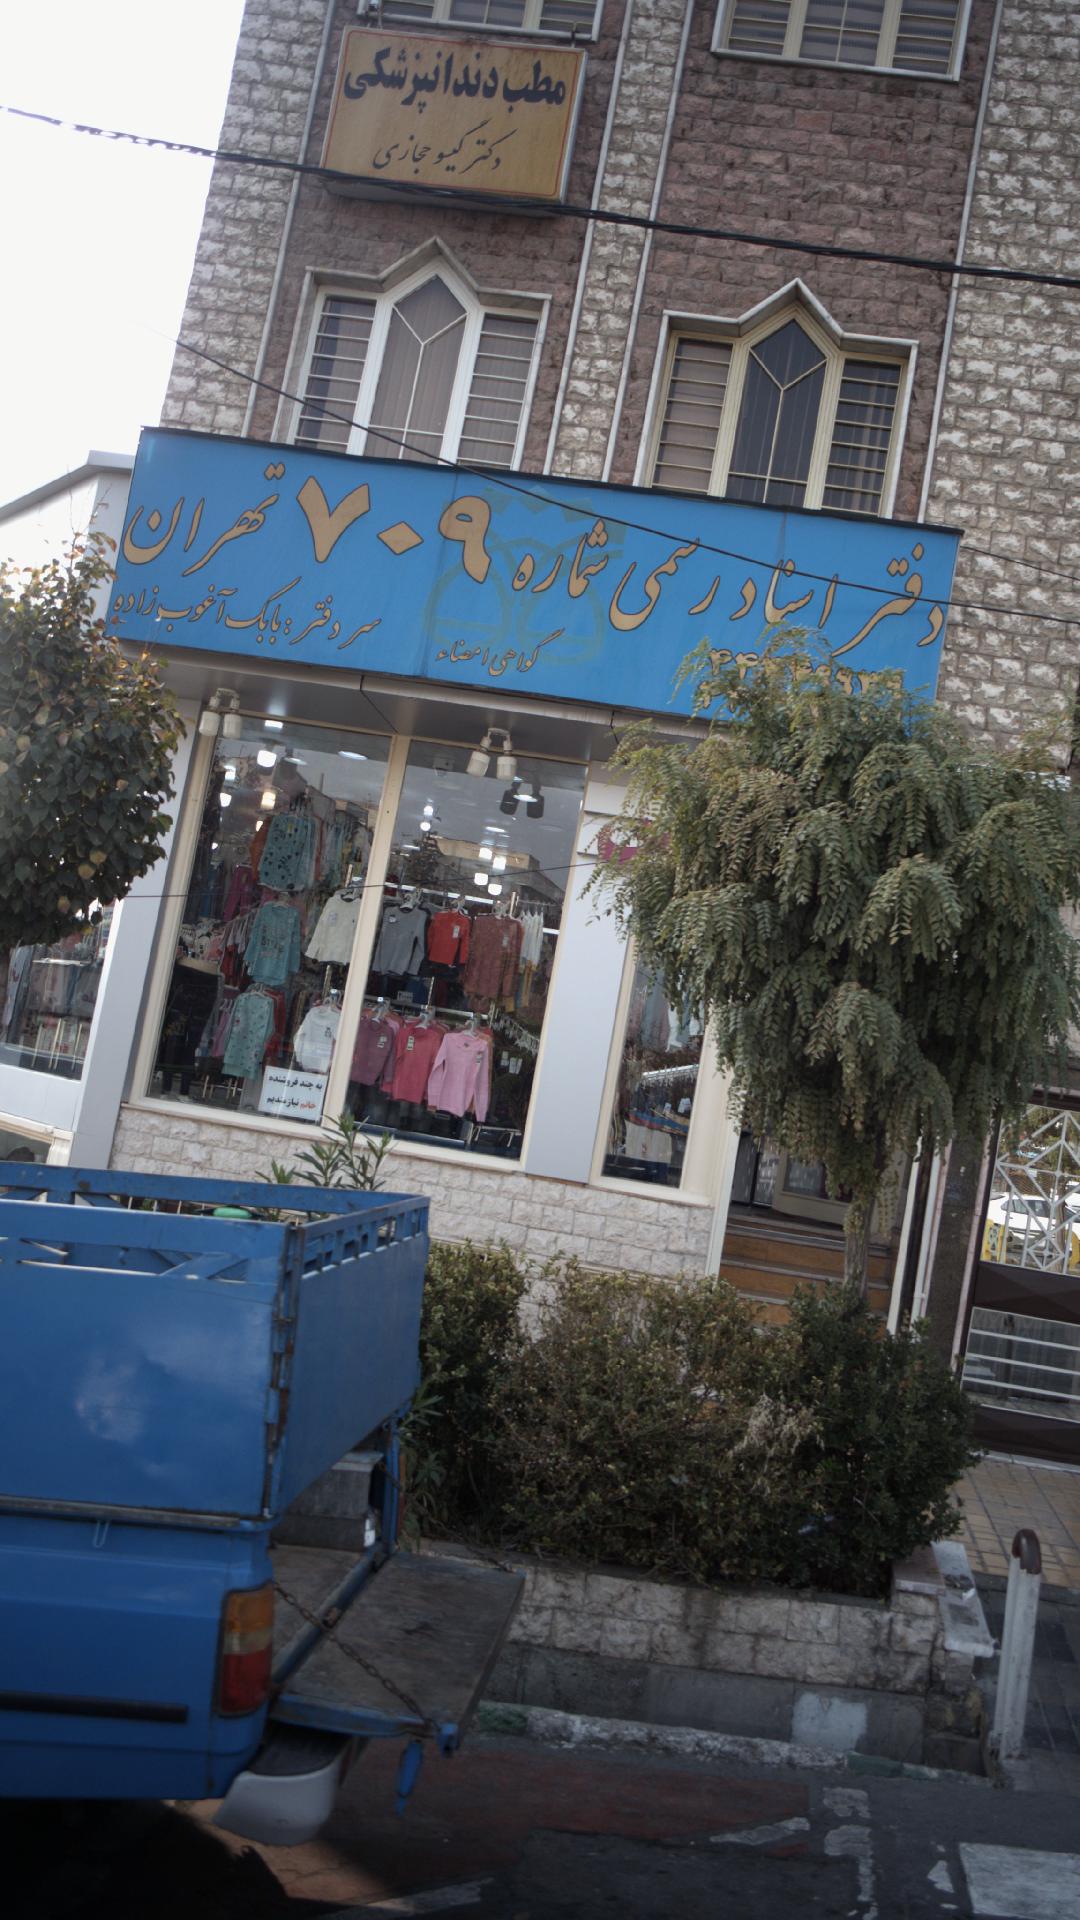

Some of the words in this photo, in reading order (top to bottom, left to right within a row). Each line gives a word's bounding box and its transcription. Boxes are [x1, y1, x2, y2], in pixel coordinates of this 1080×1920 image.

[343, 47, 499, 114] دندانپزشکی
[502, 60, 566, 112] مطب
[372, 134, 431, 173] حجازی
[459, 128, 519, 174] دکتر
[121, 462, 286, 577] تهران
[296, 475, 492, 584] ۷۰۹
[511, 518, 609, 599] شماره
[609, 537, 720, 632] رسمی
[224, 576, 302, 645] بابک
[729, 559, 839, 630] اسناد
[831, 542, 945, 658] دفتر
[488, 627, 566, 676] گواهی
[269, 1076, 298, 1088] فروشنده
[300, 1081, 314, 1090] چند
